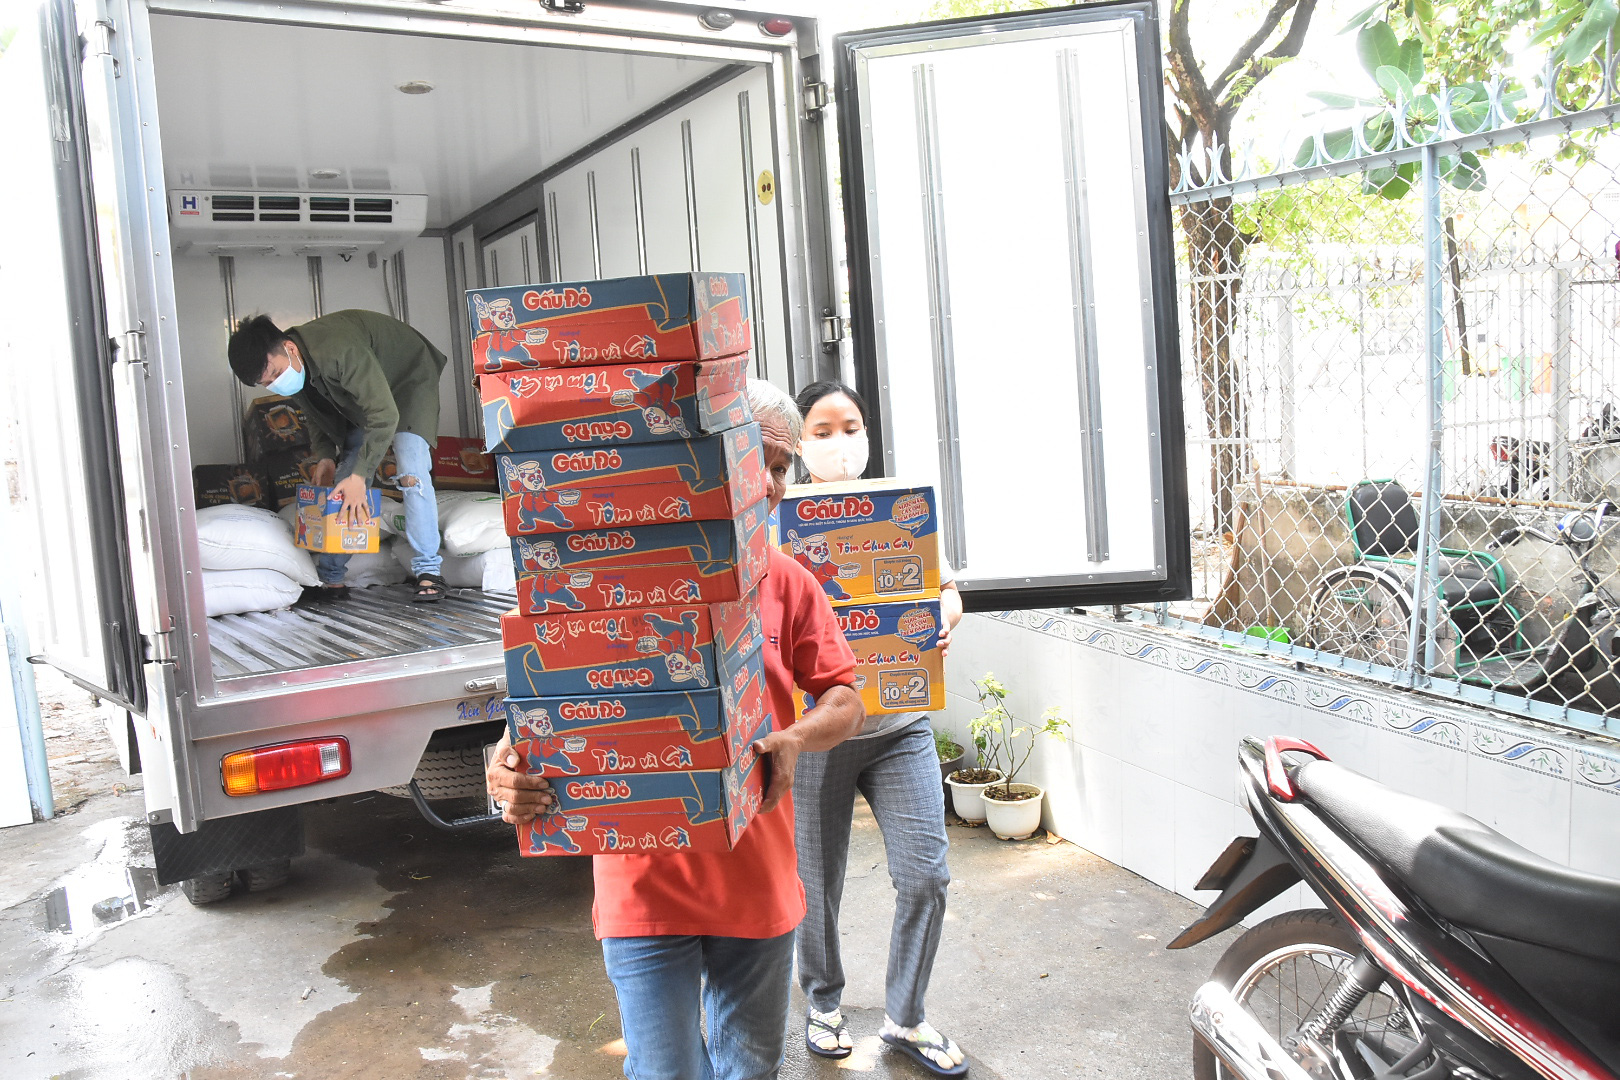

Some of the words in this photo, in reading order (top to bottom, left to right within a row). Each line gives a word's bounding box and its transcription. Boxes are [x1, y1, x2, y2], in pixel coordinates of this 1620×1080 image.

[183, 196, 196, 209] H
[553, 340, 598, 364] Tôm
[602, 343, 621, 361] và
[624, 334, 658, 359] Gà
[586, 501, 633, 525] Tôm
[636, 504, 656, 522] và
[658, 496, 693, 519] Gà
[836, 542, 860, 556] Tôm
[862, 539, 891, 553] Chua
[893, 537, 915, 552] Cay
[597, 583, 643, 607] Tôm
[647, 586, 667, 603] và
[668, 578, 702, 602] Gà
[588, 617, 633, 642] Tôm
[867, 652, 897, 666] Chua
[898, 650, 920, 666] Cay
[457, 701, 480, 720] Xin
[592, 749, 636, 771] Tôm
[639, 752, 658, 769] và
[660, 745, 694, 767] Gà
[592, 828, 635, 851] Tôm
[638, 831, 658, 849] và
[659, 826, 692, 848] Gà
